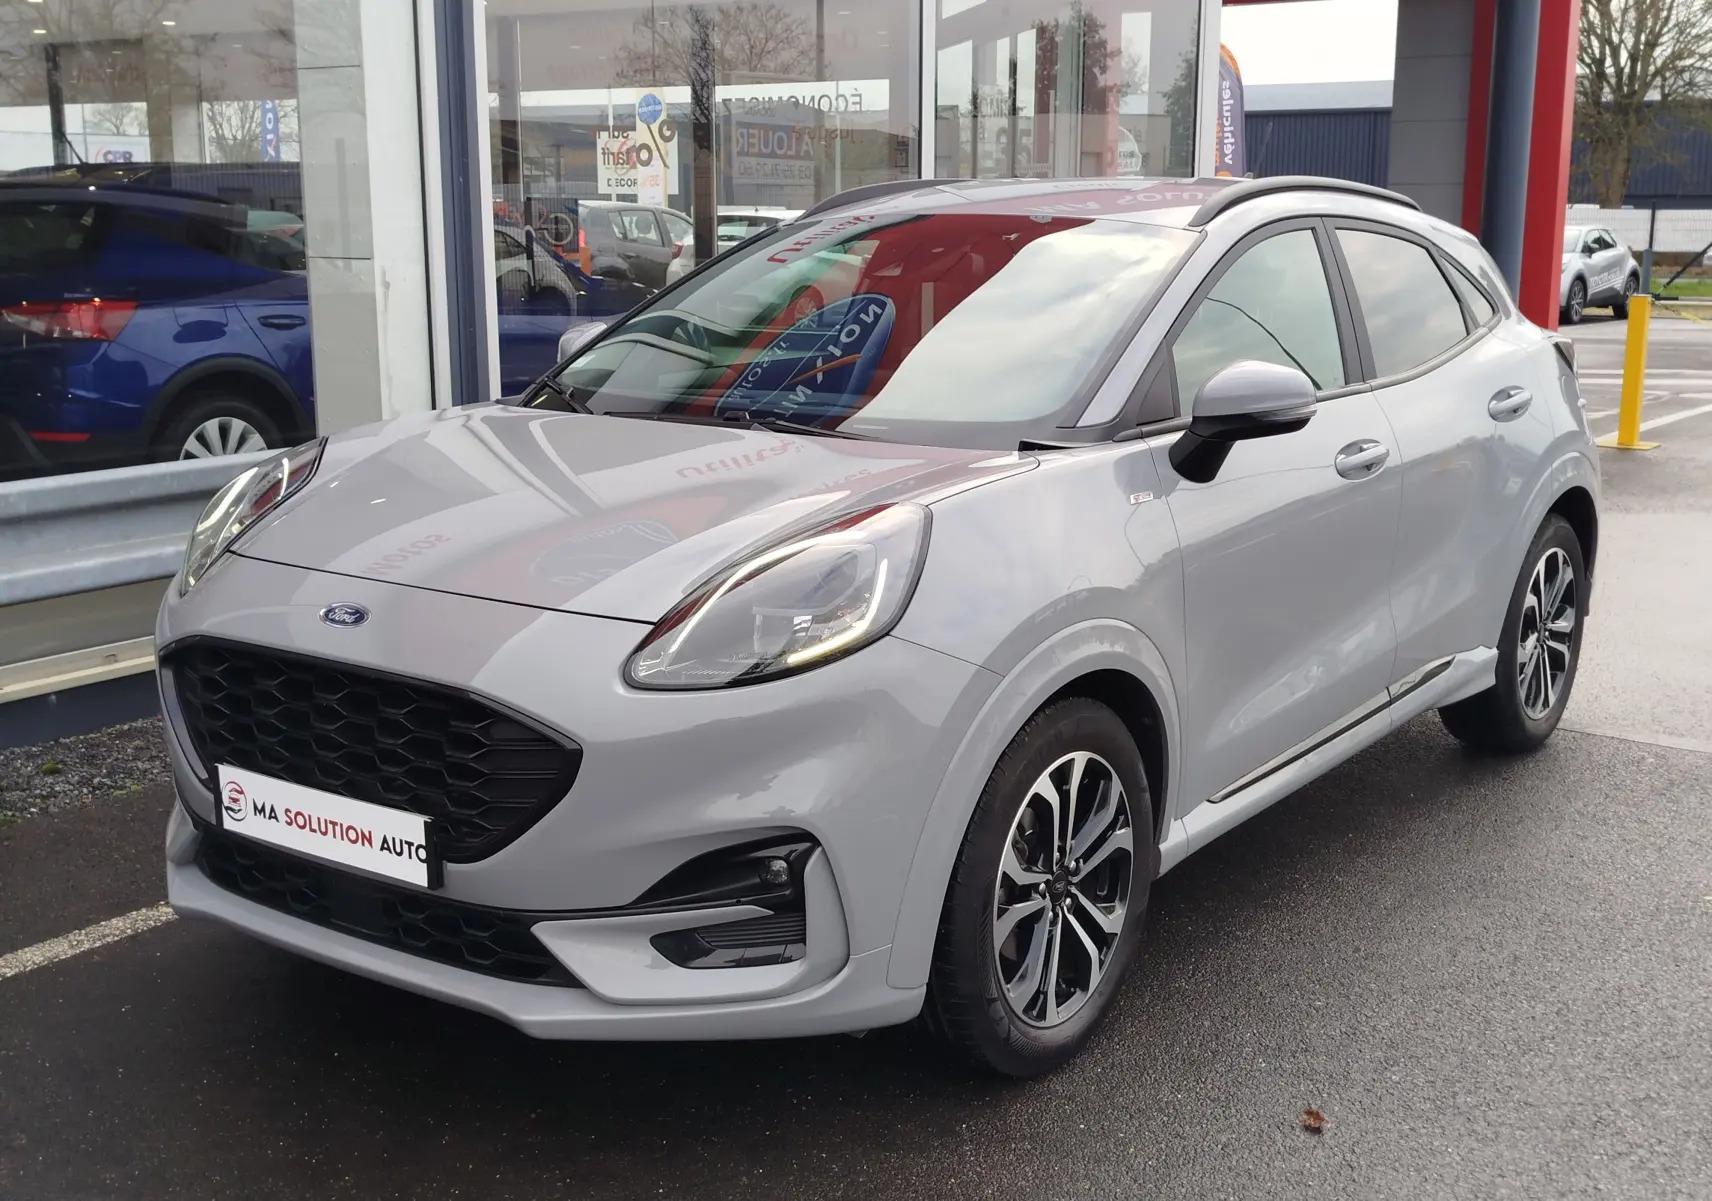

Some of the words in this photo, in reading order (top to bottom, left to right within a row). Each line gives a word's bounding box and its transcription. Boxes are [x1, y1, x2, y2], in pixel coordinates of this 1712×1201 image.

[328, 607, 360, 623] Ford
[252, 798, 280, 824] MA
[284, 808, 374, 849] SOLUTION
[380, 834, 429, 865] AUTO
